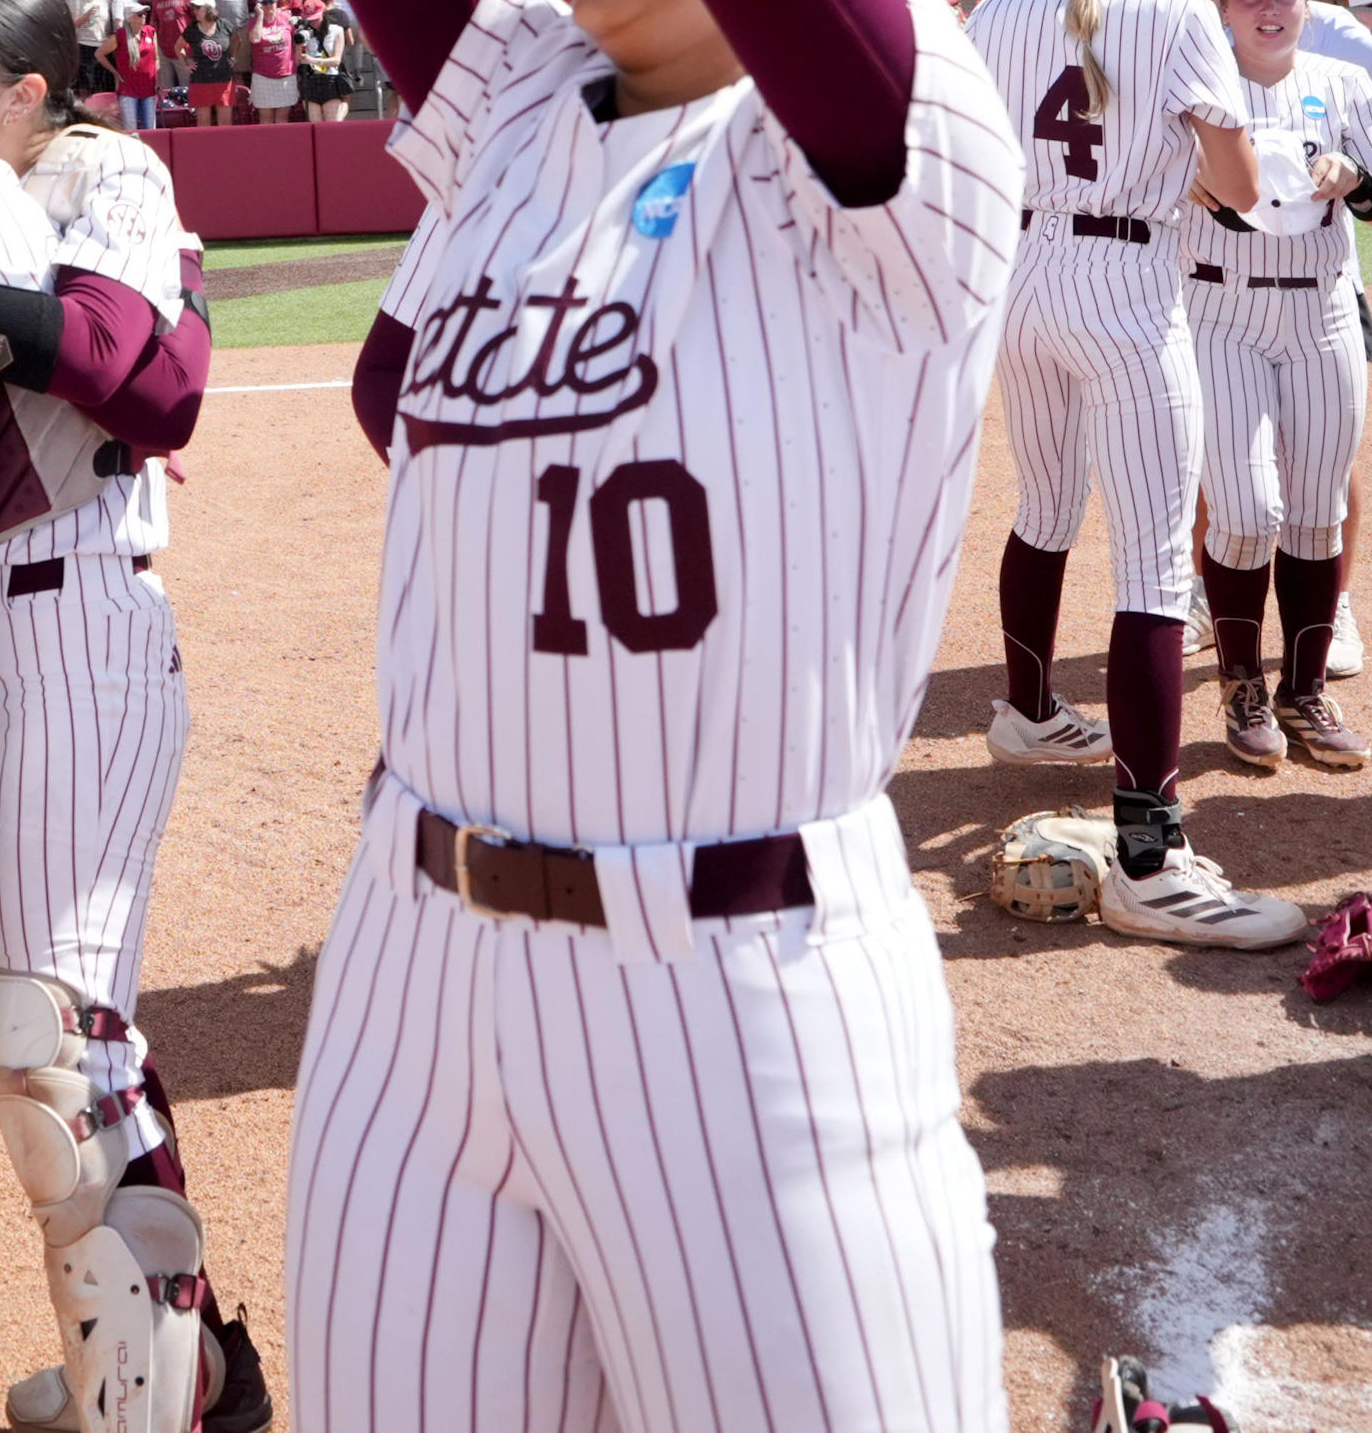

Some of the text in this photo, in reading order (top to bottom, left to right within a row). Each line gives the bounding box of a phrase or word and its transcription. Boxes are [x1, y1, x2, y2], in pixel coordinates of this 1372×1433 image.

[201, 39, 223, 62] OU
[1033, 65, 1103, 182] 4
[532, 459, 719, 656] 10
